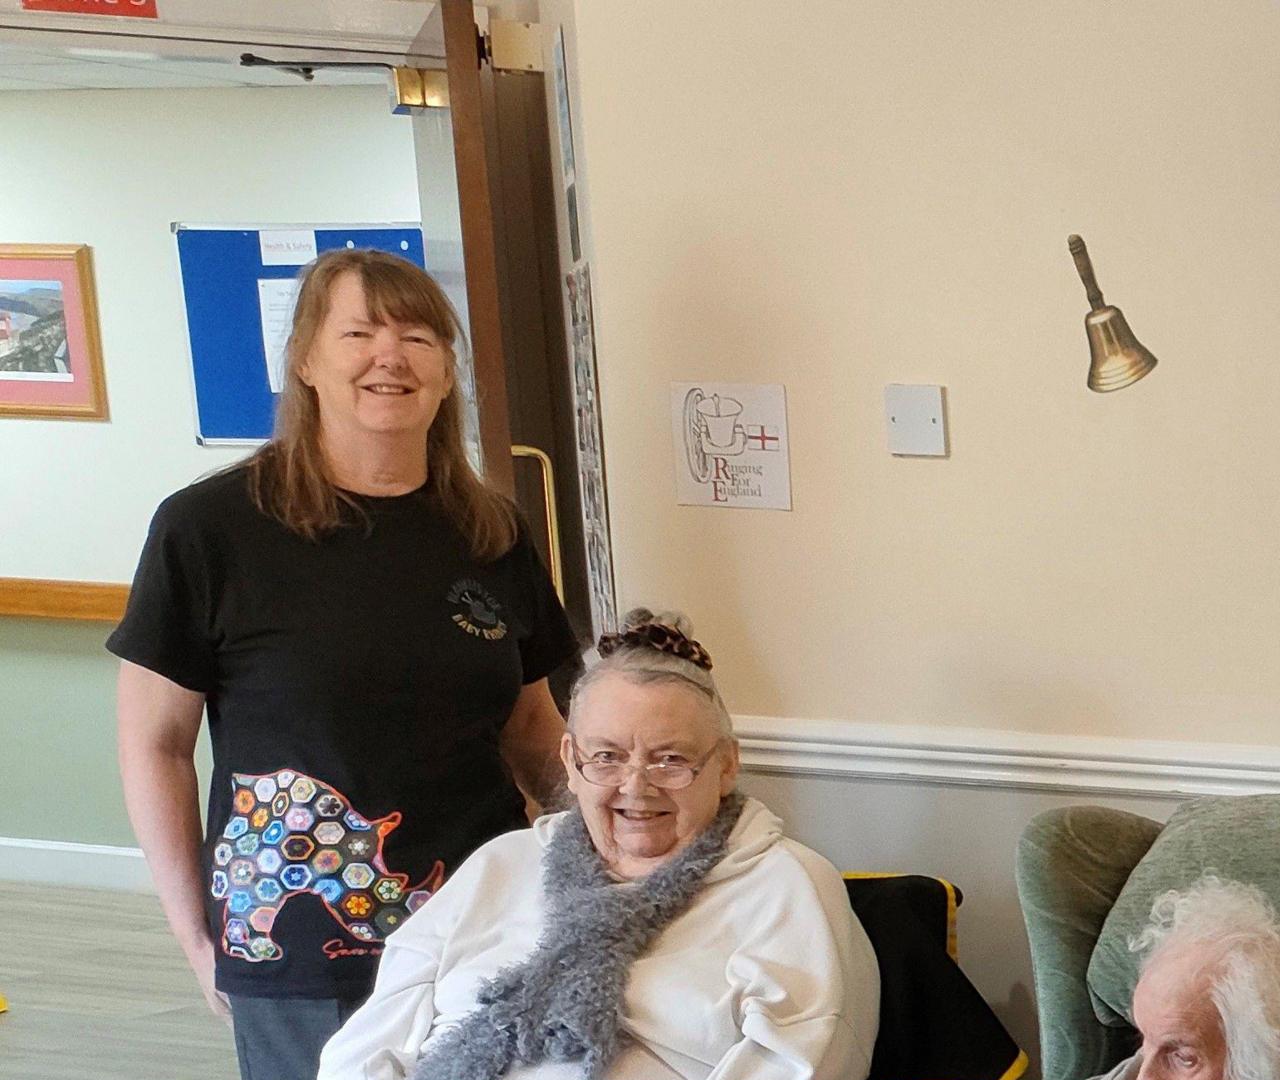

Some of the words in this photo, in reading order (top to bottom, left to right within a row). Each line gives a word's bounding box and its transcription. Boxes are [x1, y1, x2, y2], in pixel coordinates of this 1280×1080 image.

[713, 457, 762, 480] Ringing
[712, 480, 761, 502] England
[731, 473, 751, 487] For
